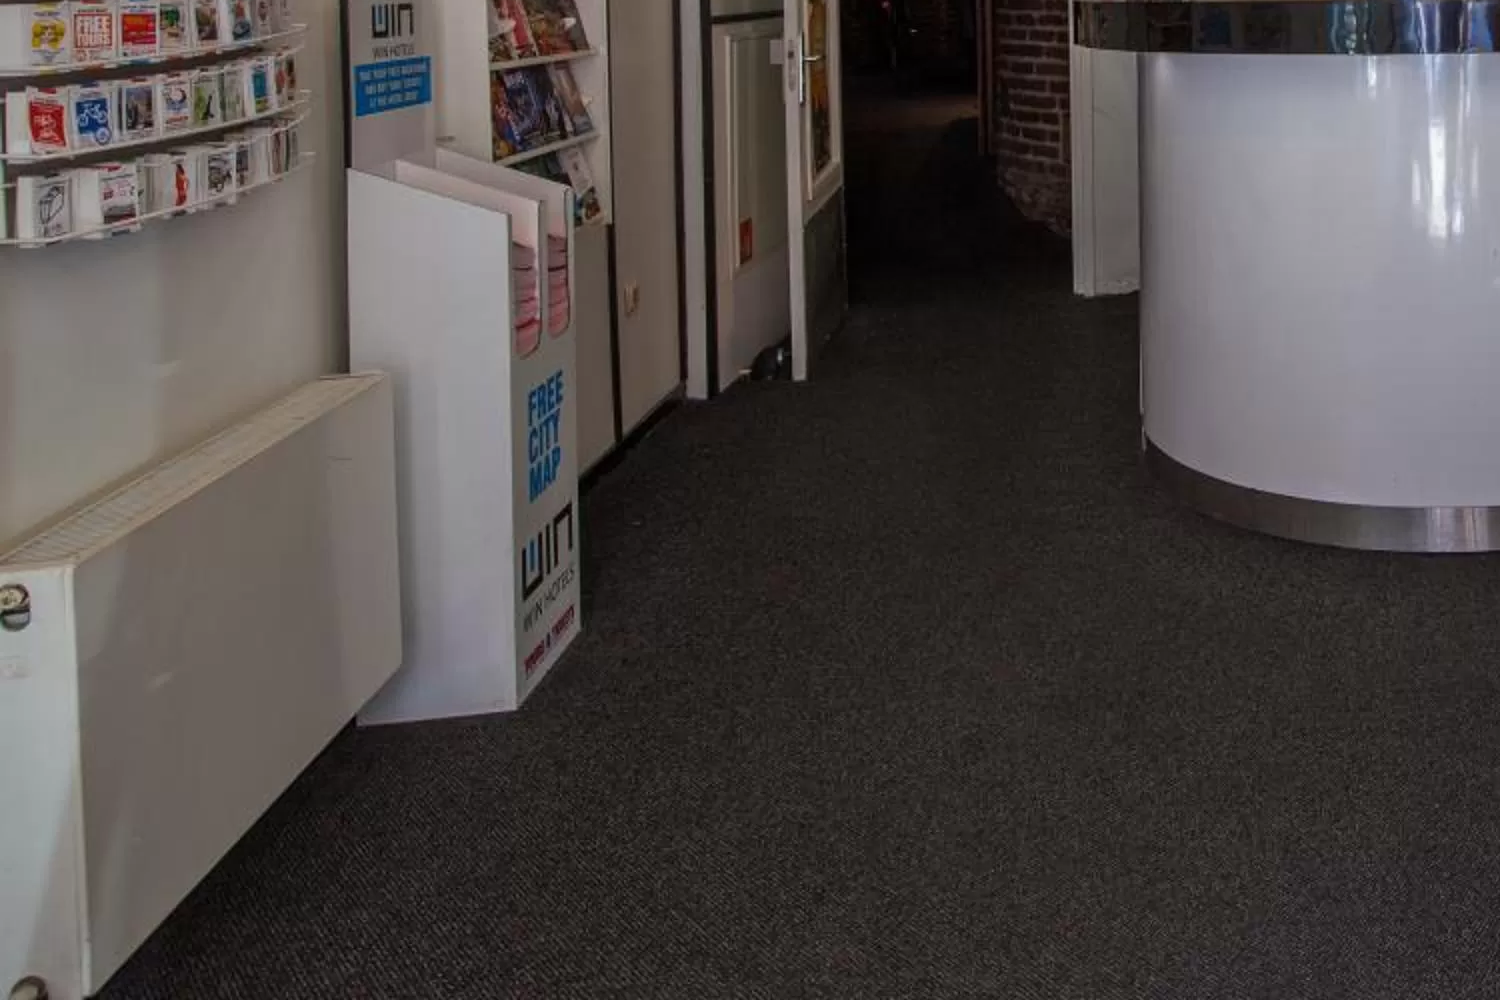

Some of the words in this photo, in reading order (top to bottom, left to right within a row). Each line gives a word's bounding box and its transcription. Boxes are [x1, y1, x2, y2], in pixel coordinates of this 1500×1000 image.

[528, 368, 563, 428] FREE
[528, 406, 561, 465] CITY
[528, 445, 562, 503] MAP
